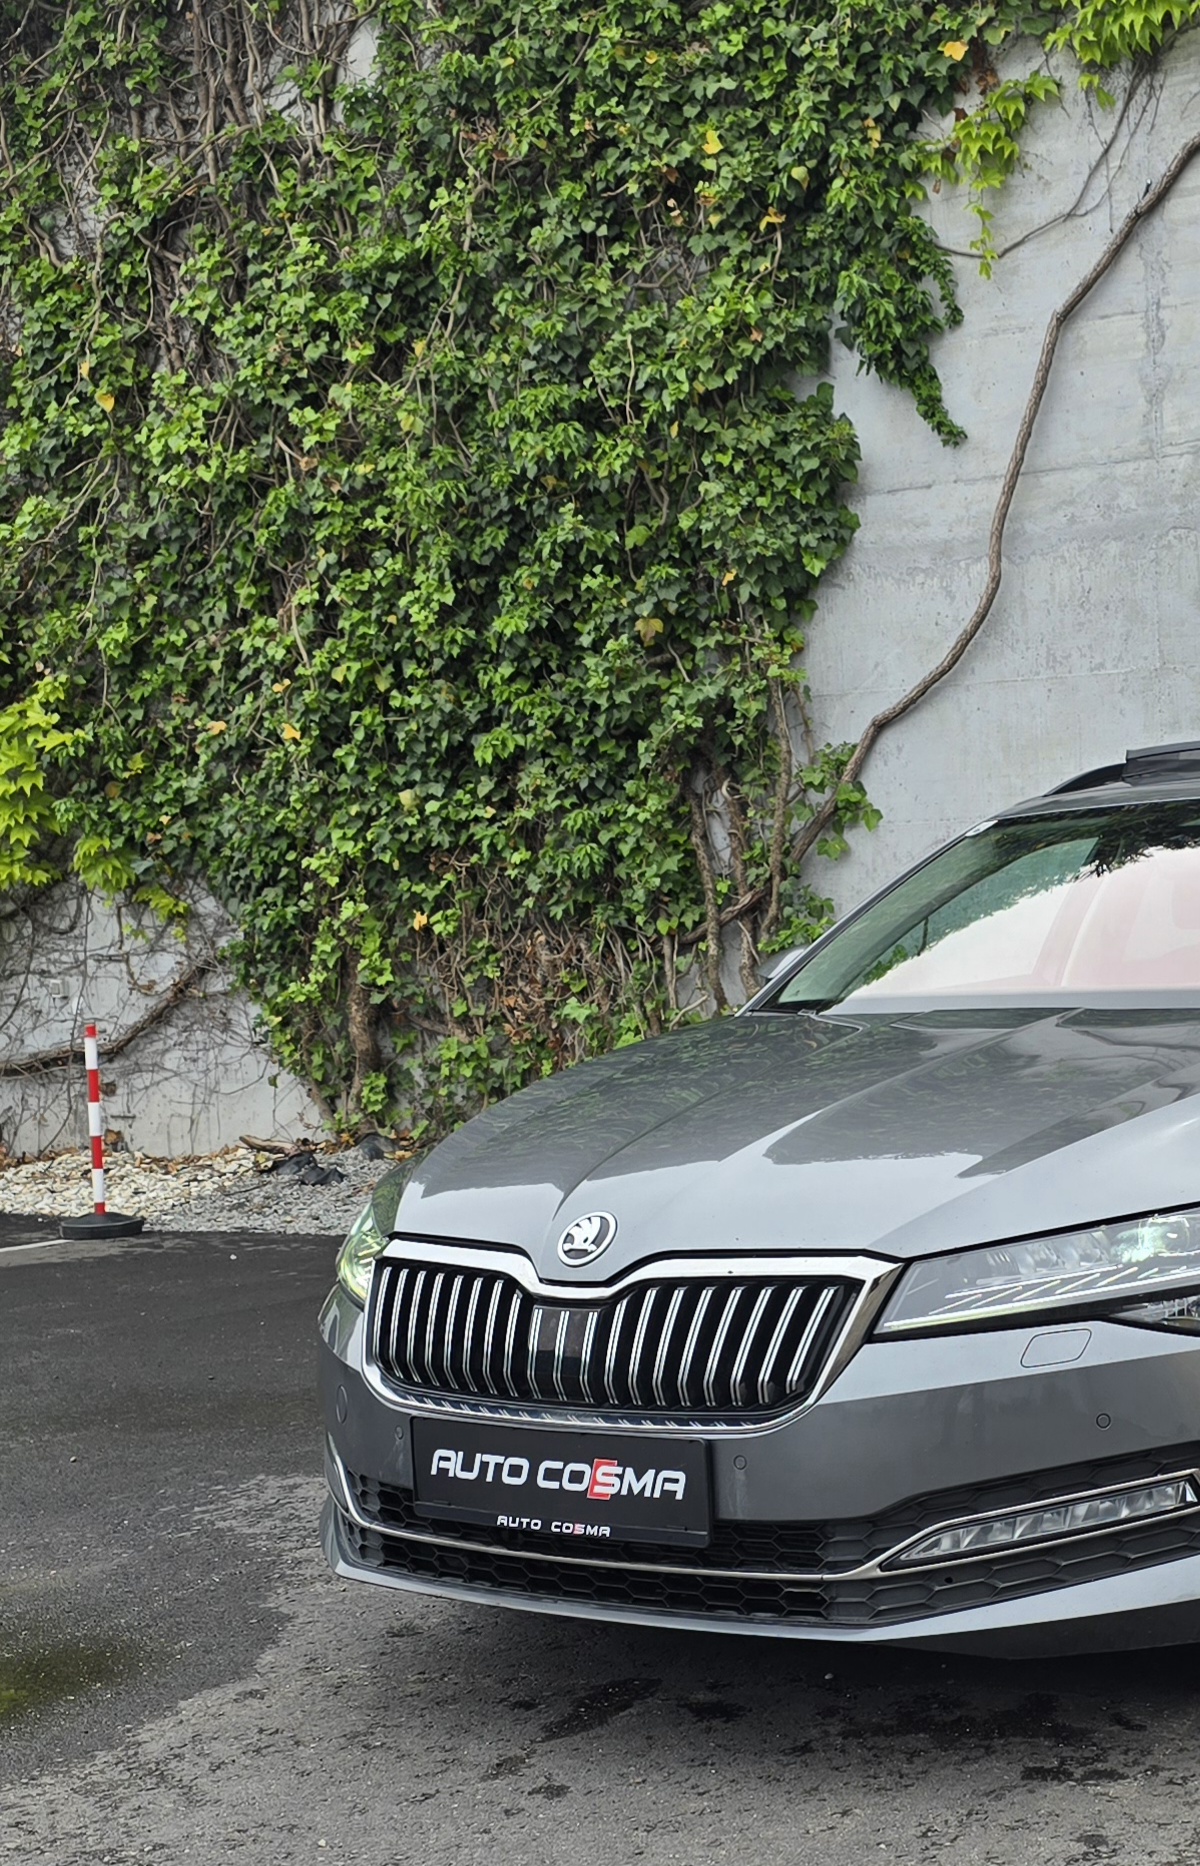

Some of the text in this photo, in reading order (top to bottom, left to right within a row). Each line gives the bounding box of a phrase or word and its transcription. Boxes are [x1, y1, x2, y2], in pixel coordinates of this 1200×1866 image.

[430, 1449, 687, 1500] AUTO COSMA
[496, 1515, 611, 1538] AUTO COSMA
